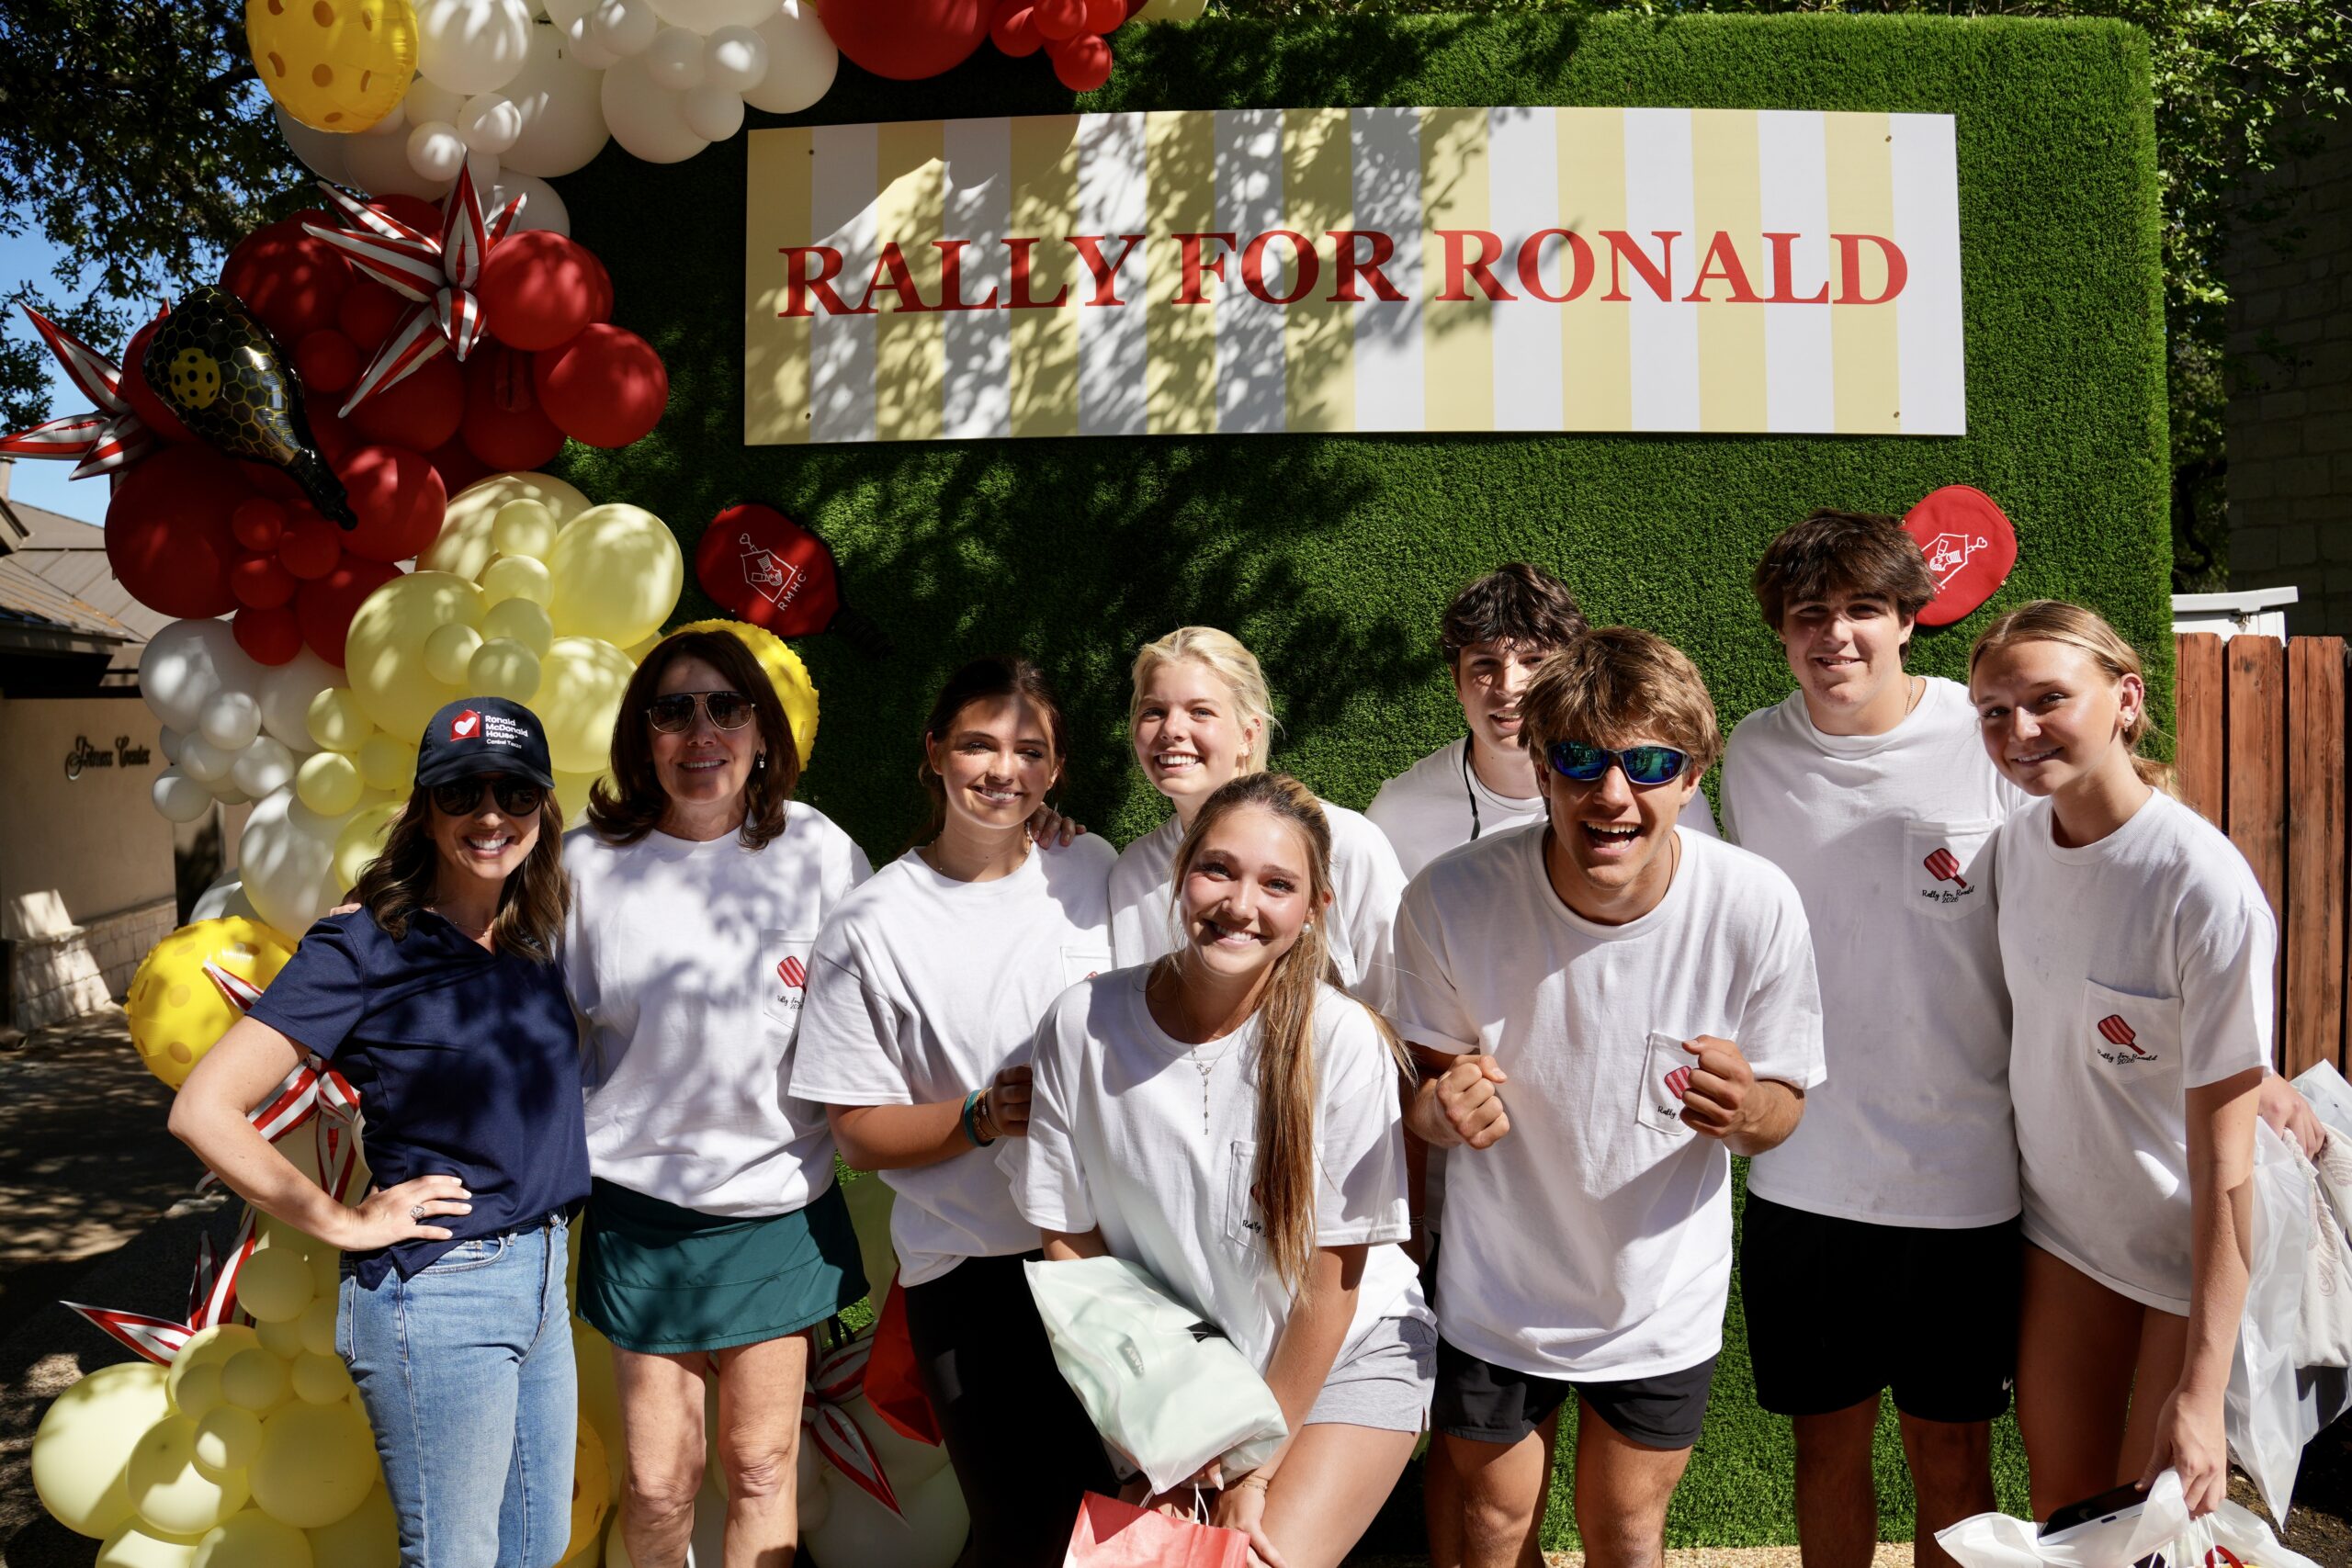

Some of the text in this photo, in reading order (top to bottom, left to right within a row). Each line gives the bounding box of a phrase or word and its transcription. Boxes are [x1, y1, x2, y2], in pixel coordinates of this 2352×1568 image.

[777, 228, 1908, 318] RALLY FOR RONALD
[777, 572, 807, 611] RMHC
[485, 715, 515, 726] Ronald
[485, 723, 528, 737] McDonald
[507, 739, 522, 749] Texas
[64, 734, 151, 781] Fitness Center
[1922, 889, 1939, 901] Rally
[1657, 1105, 1677, 1119] Rally
[1242, 1219, 1261, 1233] Rally
